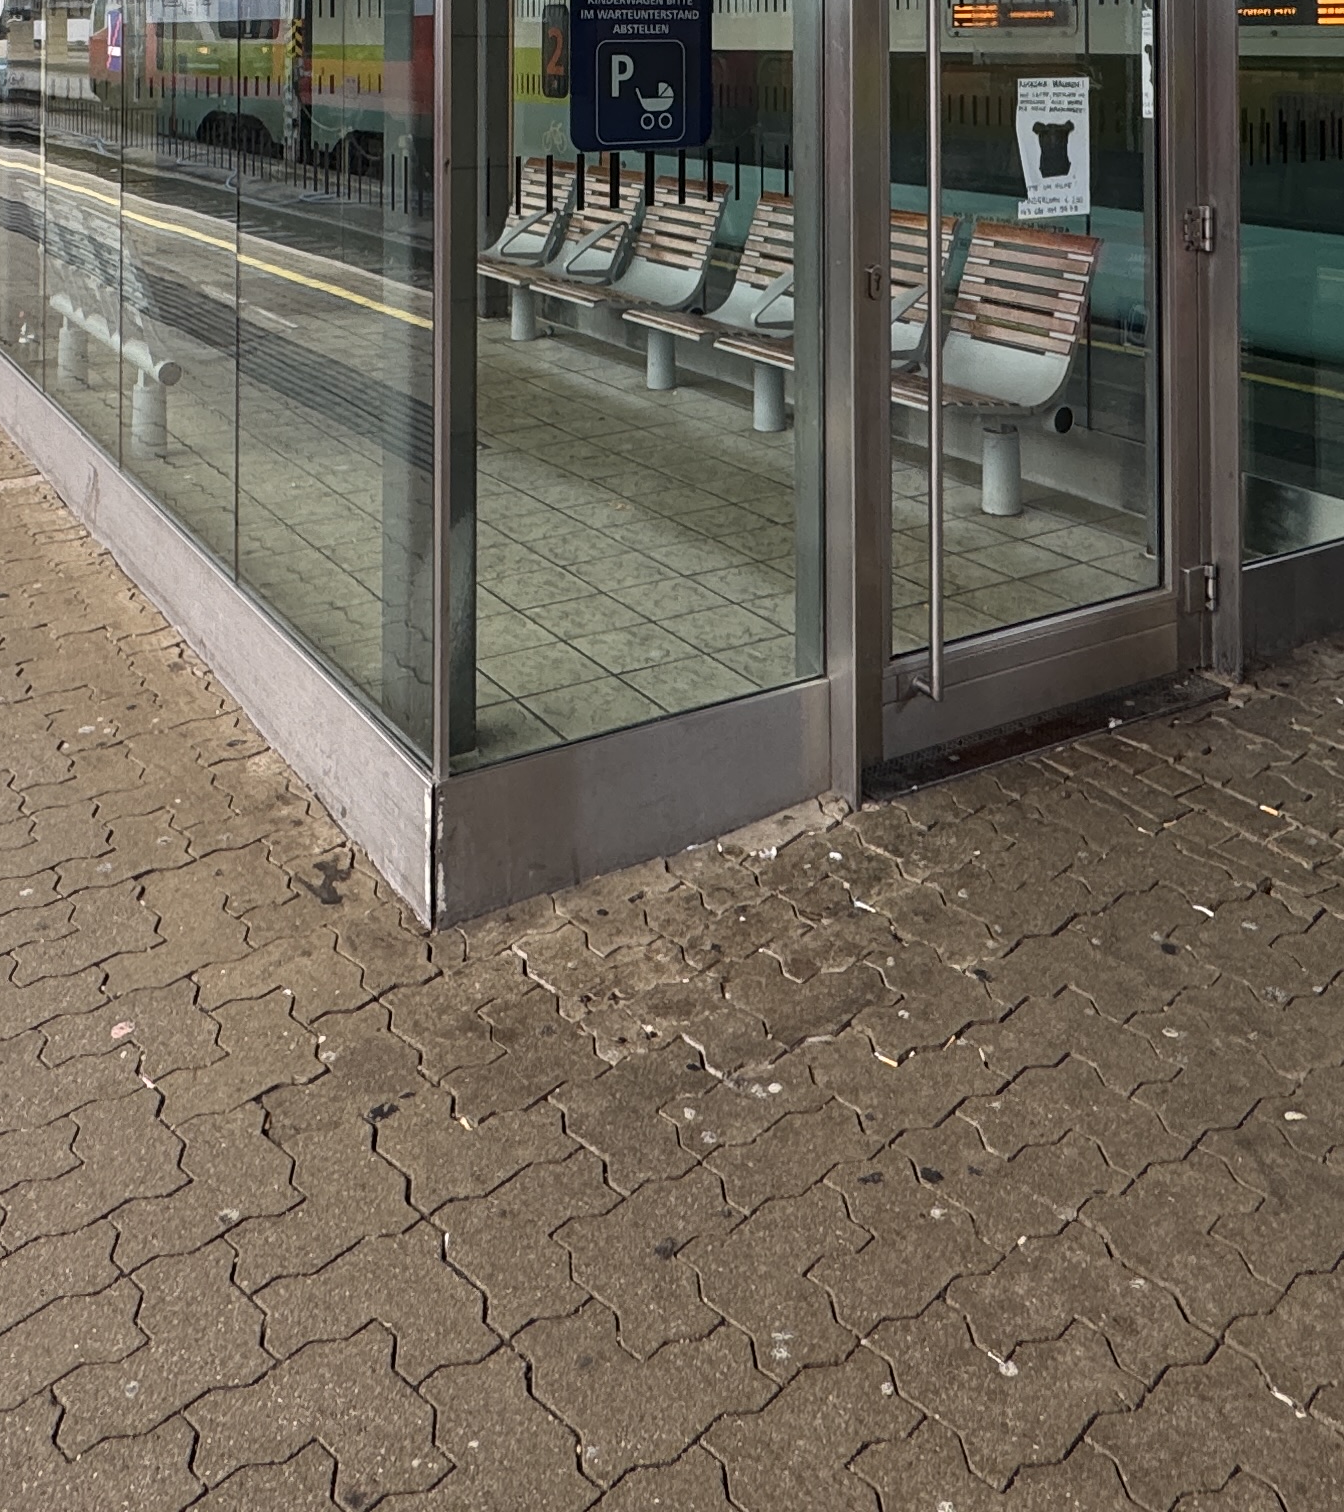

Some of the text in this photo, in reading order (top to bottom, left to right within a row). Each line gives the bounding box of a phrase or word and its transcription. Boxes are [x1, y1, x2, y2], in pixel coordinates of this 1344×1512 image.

[580, 9, 700, 20] IM WARTEUNTERSTAND
[612, 24, 670, 35] ABSTELLEN
[546, 26, 565, 76] 2
[611, 54, 635, 98] P
